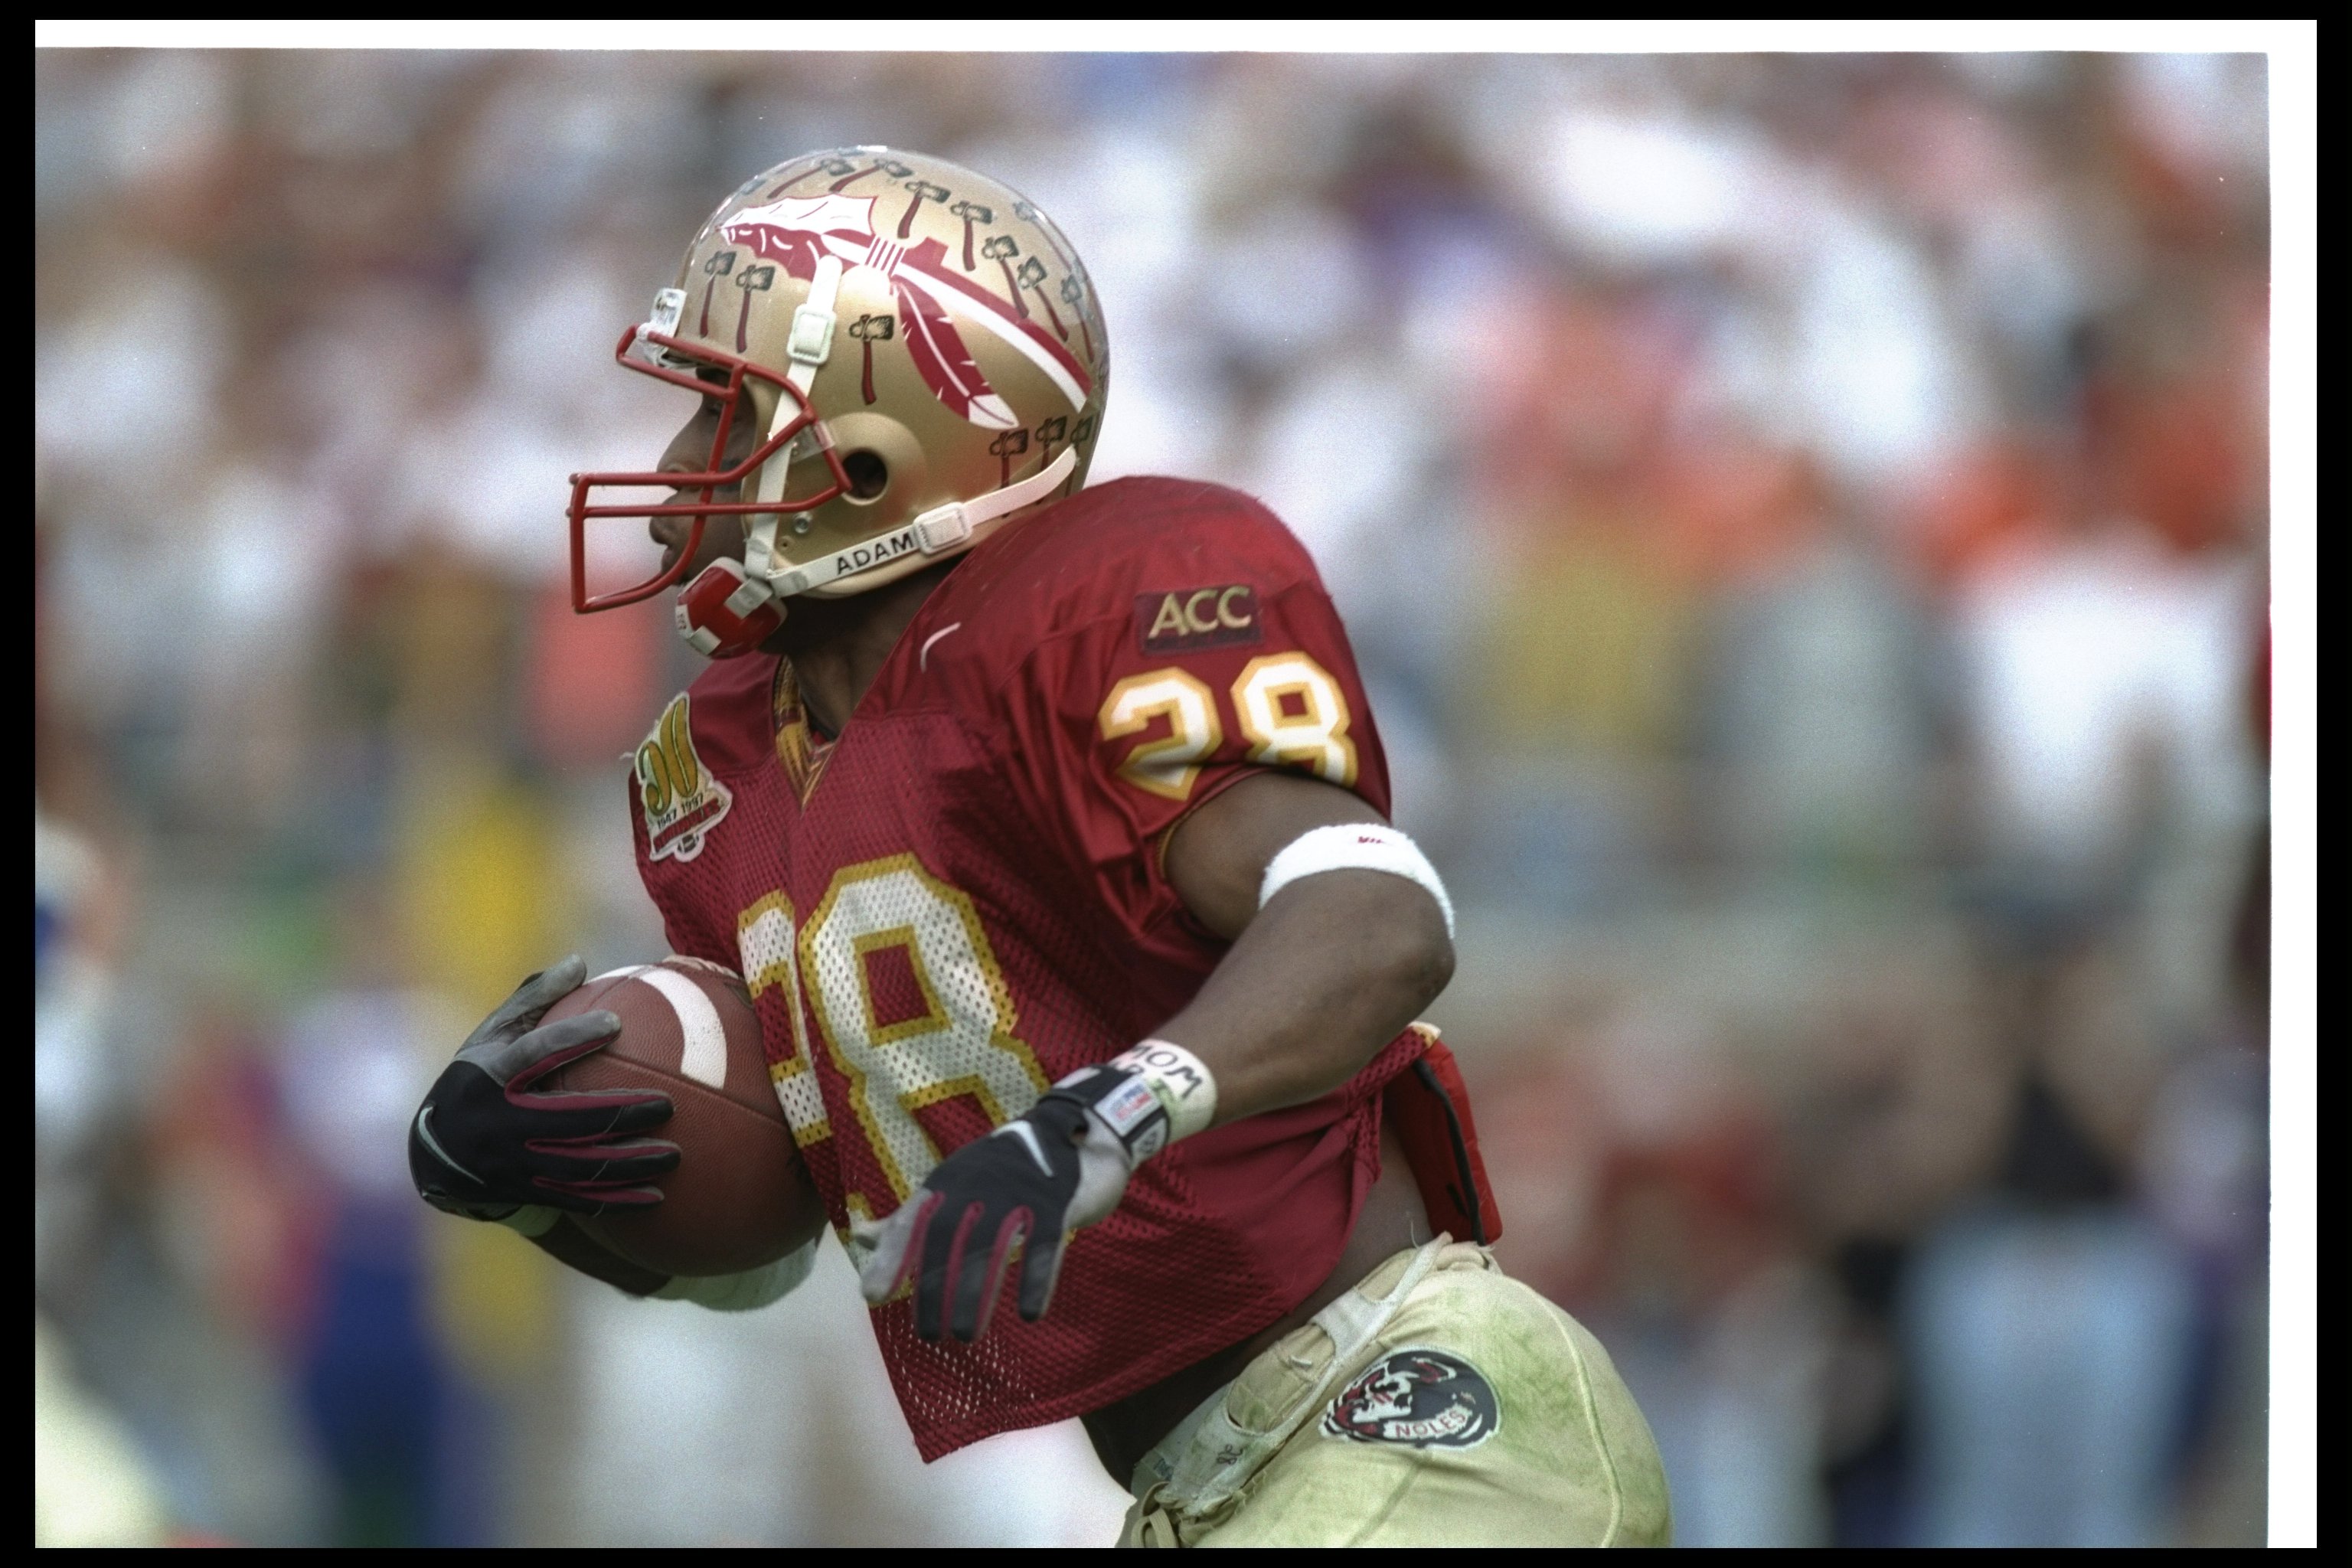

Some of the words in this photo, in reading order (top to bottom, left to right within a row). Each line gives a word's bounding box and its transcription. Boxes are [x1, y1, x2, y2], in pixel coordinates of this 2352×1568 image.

[1148, 586, 1252, 640] ACC
[1099, 651, 1358, 802] 28
[1395, 1410, 1468, 1439] NOLES
